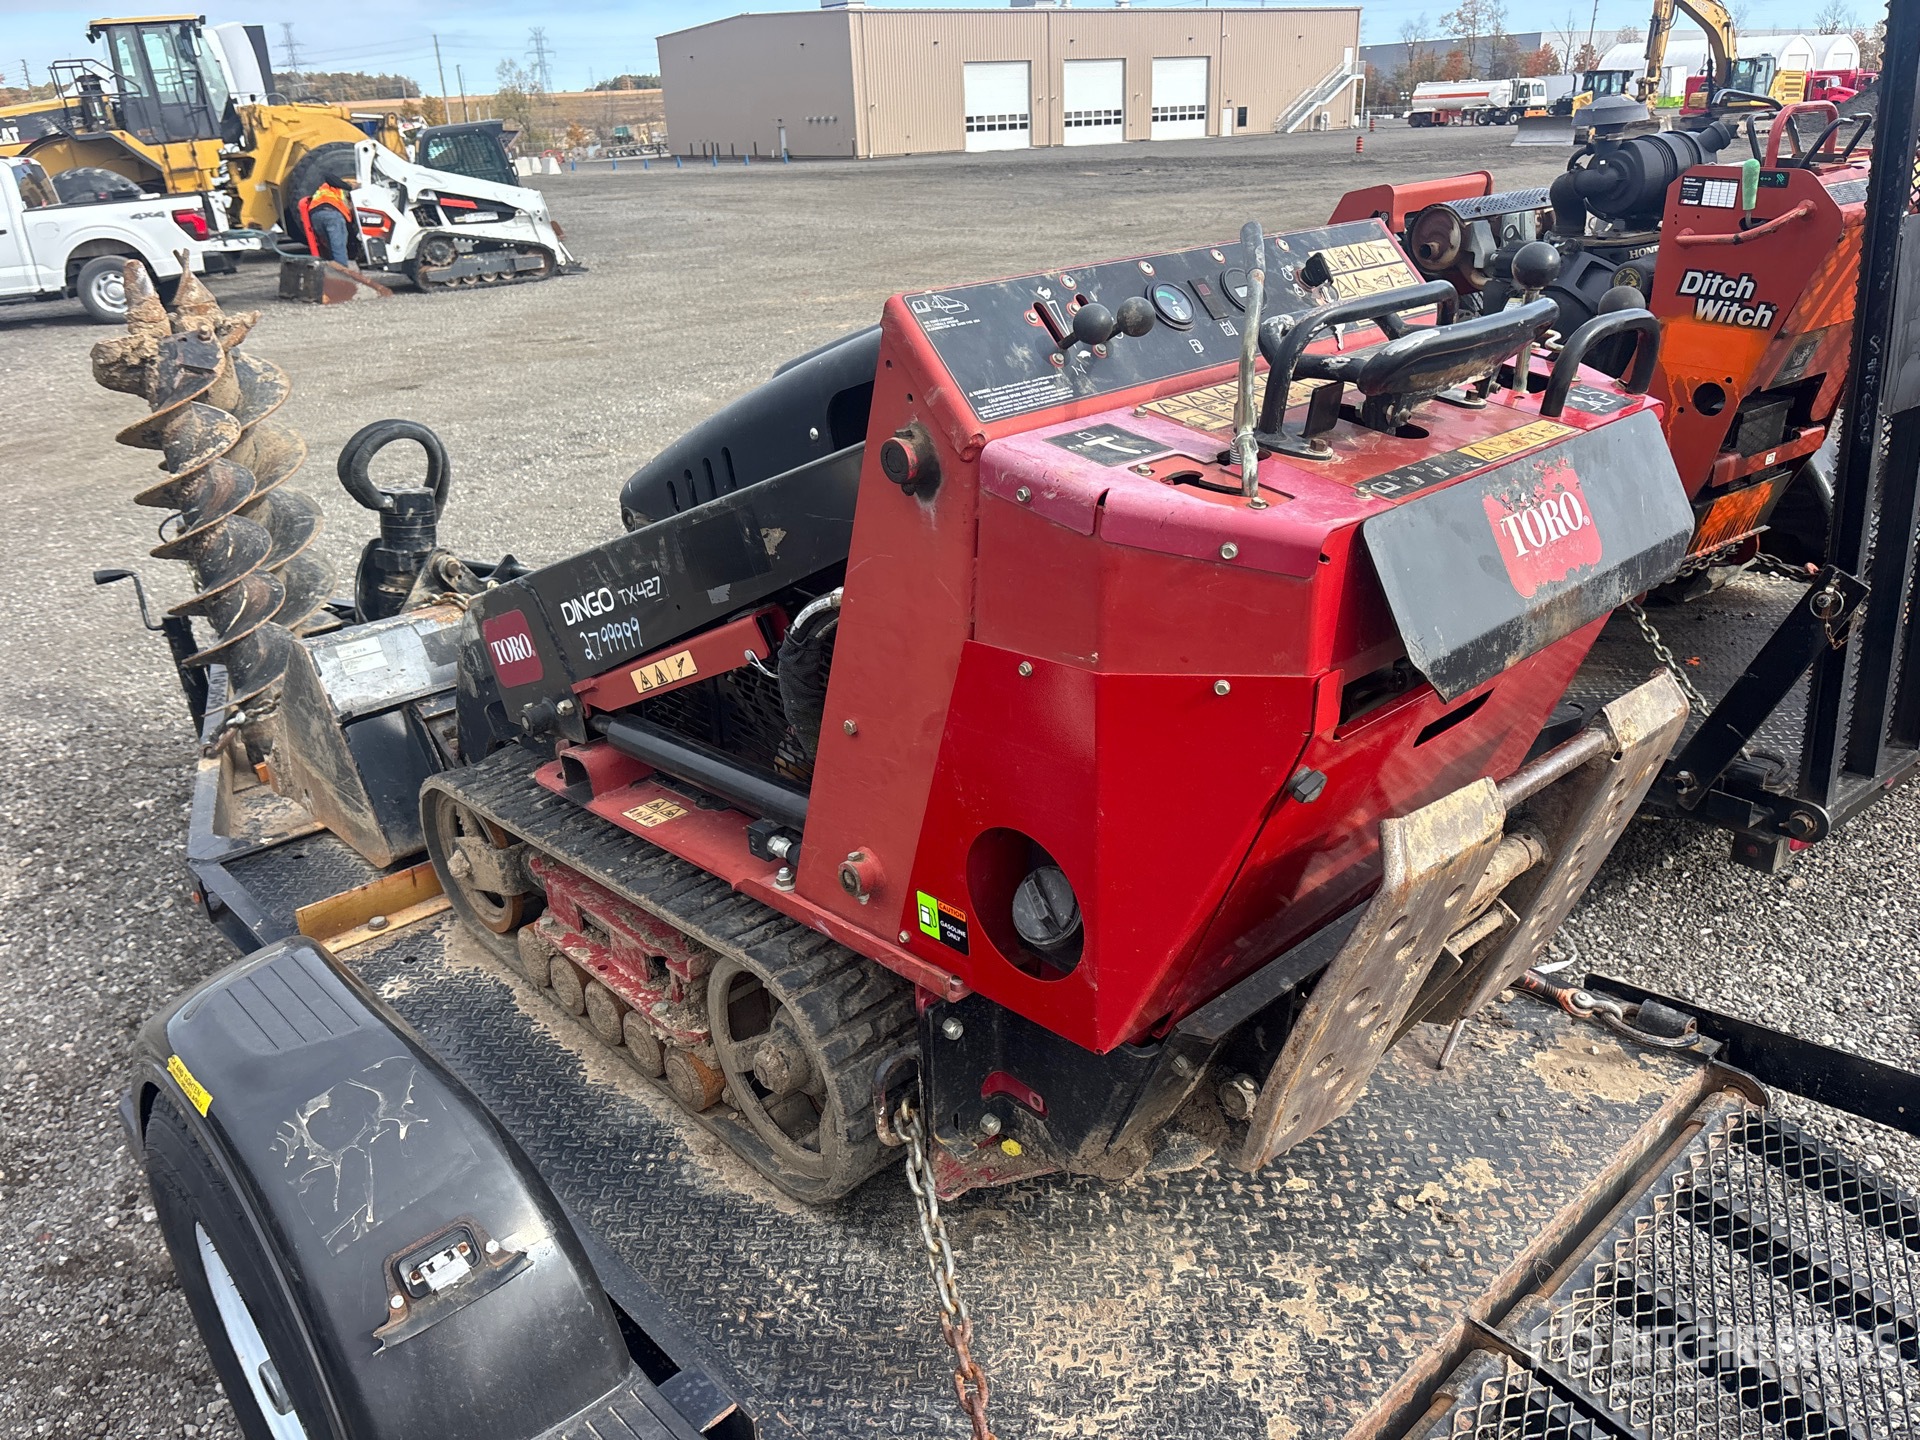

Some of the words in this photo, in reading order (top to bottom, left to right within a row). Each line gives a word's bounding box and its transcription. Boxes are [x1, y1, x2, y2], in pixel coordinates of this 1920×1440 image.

[0, 126, 20, 145] AT
[1680, 271, 1755, 299] Ditch
[1695, 298, 1773, 328] Witch
[1500, 491, 1583, 558] TORO
[560, 587, 615, 626] DINGO
[490, 633, 532, 666] TORO
[580, 617, 643, 661] 2799999
[939, 903, 964, 920] CAUTION
[940, 920, 966, 938] GASOLINE
[947, 930, 961, 942] ONLY
